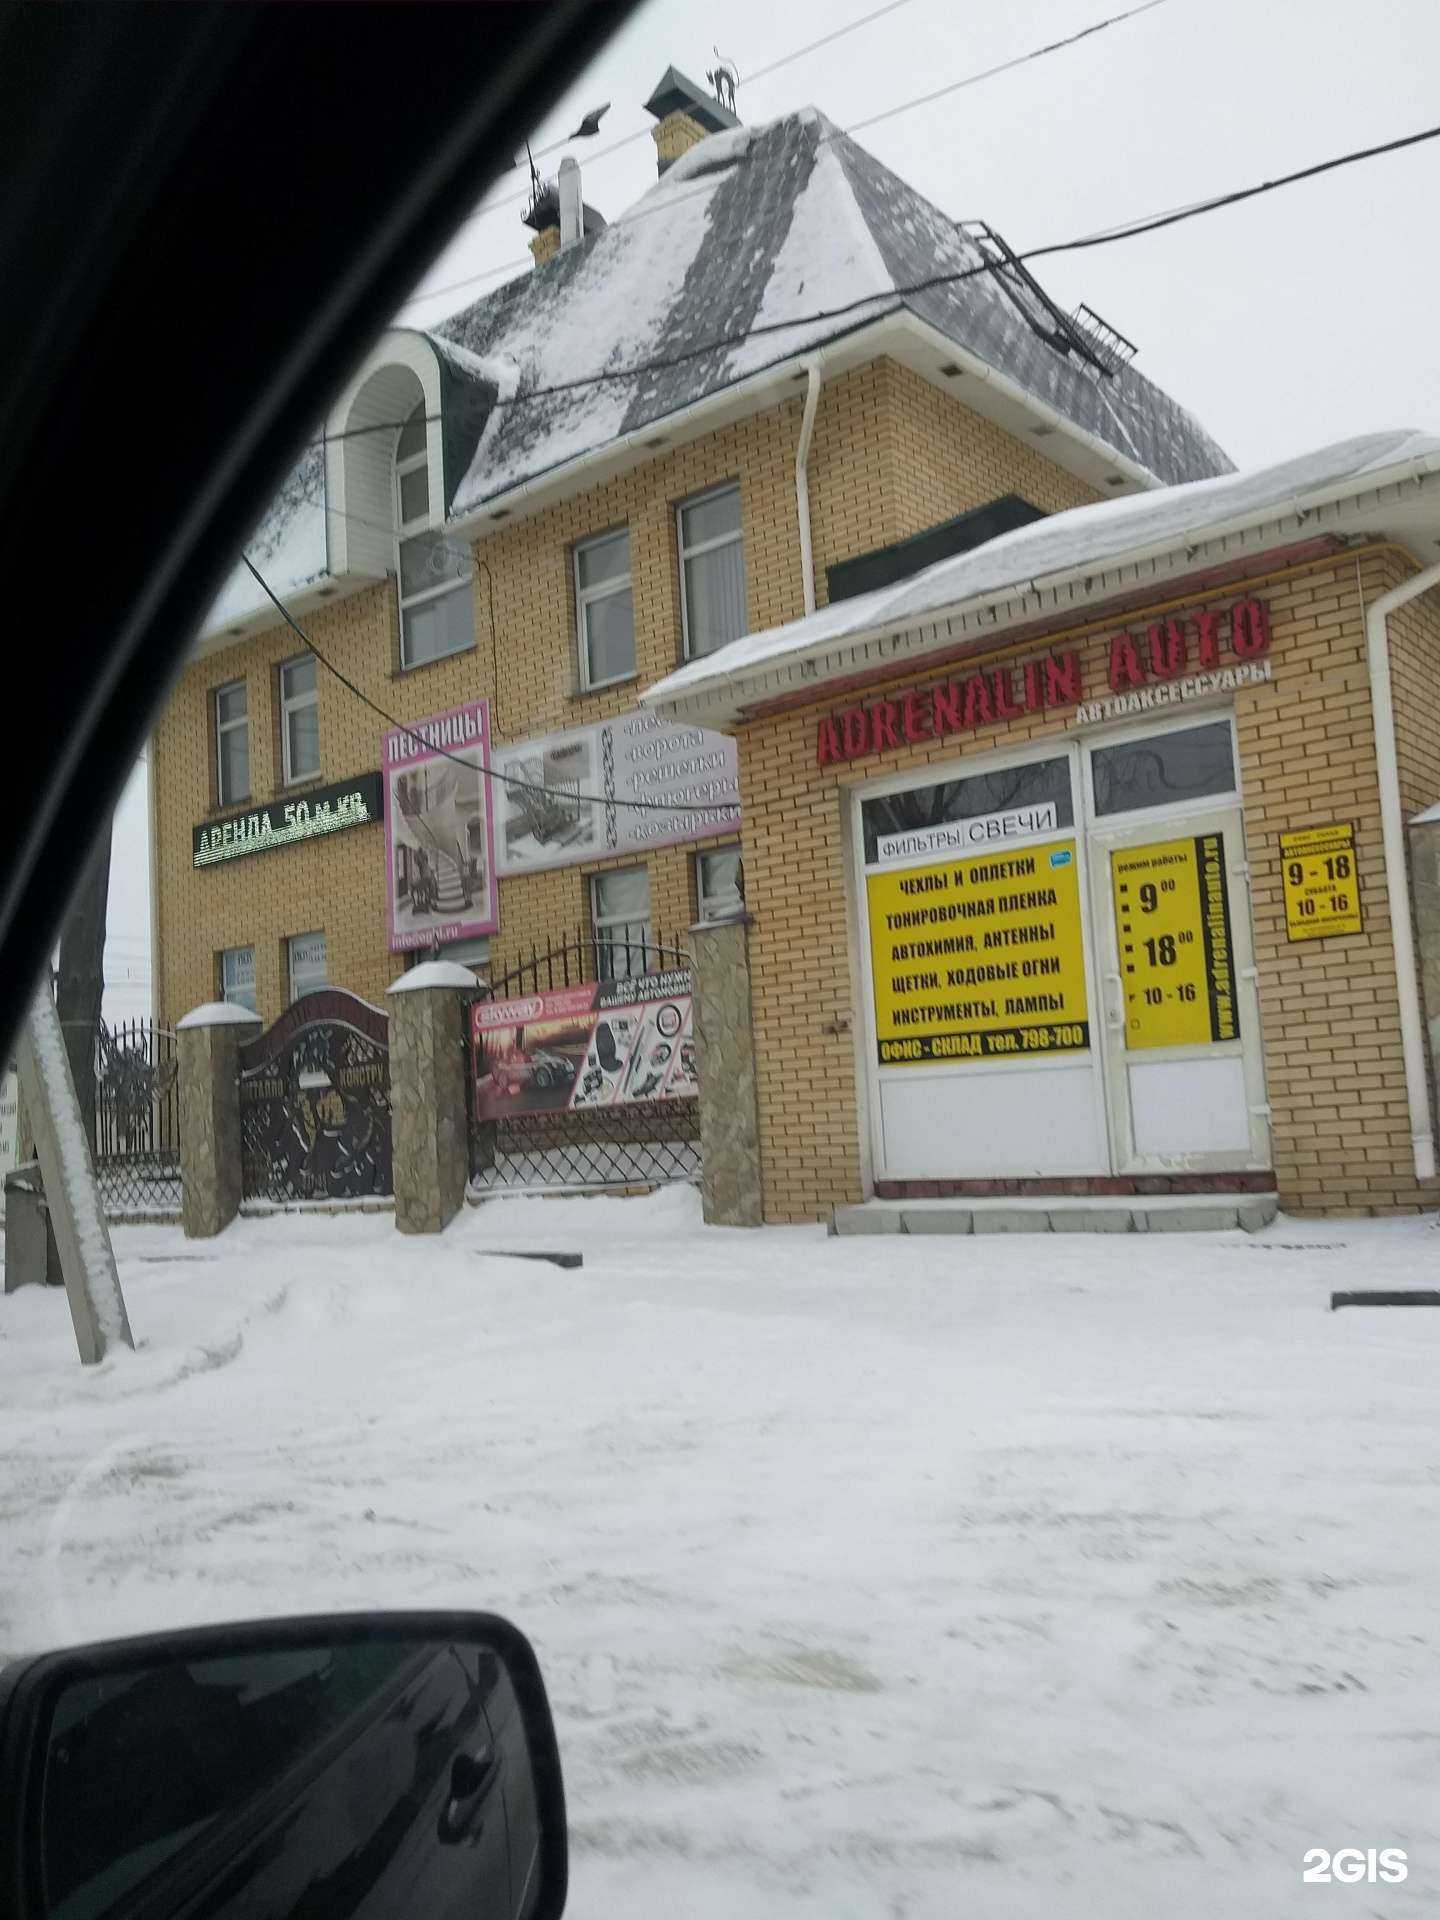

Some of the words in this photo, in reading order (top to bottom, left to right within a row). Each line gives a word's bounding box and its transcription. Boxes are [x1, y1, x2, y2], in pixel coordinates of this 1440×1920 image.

[816, 648, 1082, 765] ADRENALIN
[1109, 598, 1271, 691] AUTO
[1076, 660, 1273, 725] АВТОАКСЕССУАРЫ
[283, 800, 310, 827] 50
[882, 829, 960, 858] ФИЛЬТРЫ
[968, 809, 1053, 843] СВЕЧИ
[899, 872, 948, 895] ЧЕХЛЫ
[954, 869, 964, 886] И
[969, 856, 1036, 884] ОПЛЕТКИ
[1288, 862, 1304, 887] 9
[1324, 854, 1351, 881] 18
[886, 898, 997, 930] ТОНИРОВОЧНАЯ
[998, 887, 1058, 912] ПЛЕНКА
[1297, 898, 1315, 917] 10
[1330, 894, 1348, 912] 16
[983, 923, 1055, 948] АНТЕННЫ
[947, 961, 1019, 987] ХОДОВЫЕ
[1022, 956, 1061, 976] ОГНИ
[1004, 992, 1065, 1016] ЛАМПЫ
[1143, 986, 1163, 1006] 10
[1175, 983, 1197, 1003] 16
[881, 1039, 922, 1061] ОФИС
[931, 1032, 983, 1057] СКЛАД
[1021, 1026, 1084, 1050] 798-700
